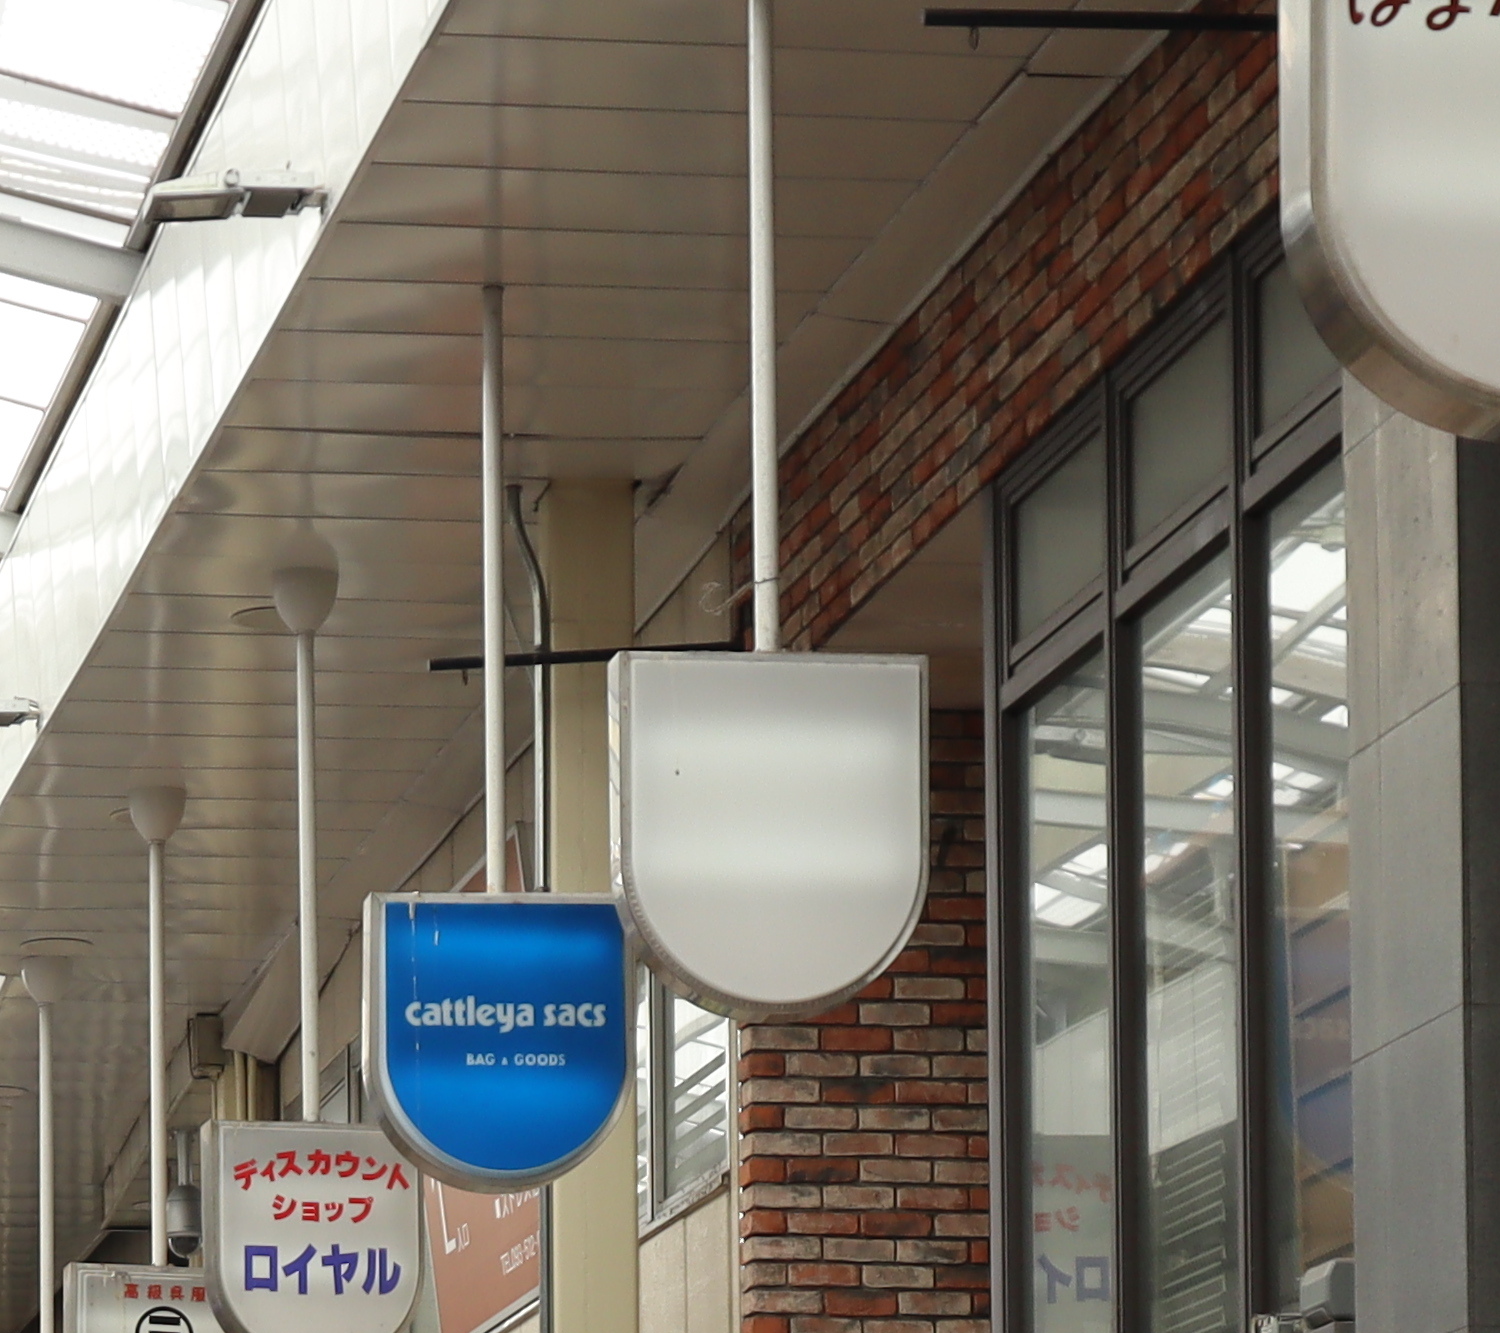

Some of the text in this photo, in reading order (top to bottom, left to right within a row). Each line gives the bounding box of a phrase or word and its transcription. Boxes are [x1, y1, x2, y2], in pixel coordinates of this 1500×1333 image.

[404, 995, 608, 1034] cattleya sacs
[465, 1052, 567, 1067] BAG GOODS
[232, 1148, 411, 1192] ディスカウント
[271, 1194, 375, 1224] ショップ
[243, 1241, 402, 1296] ロイヤル
